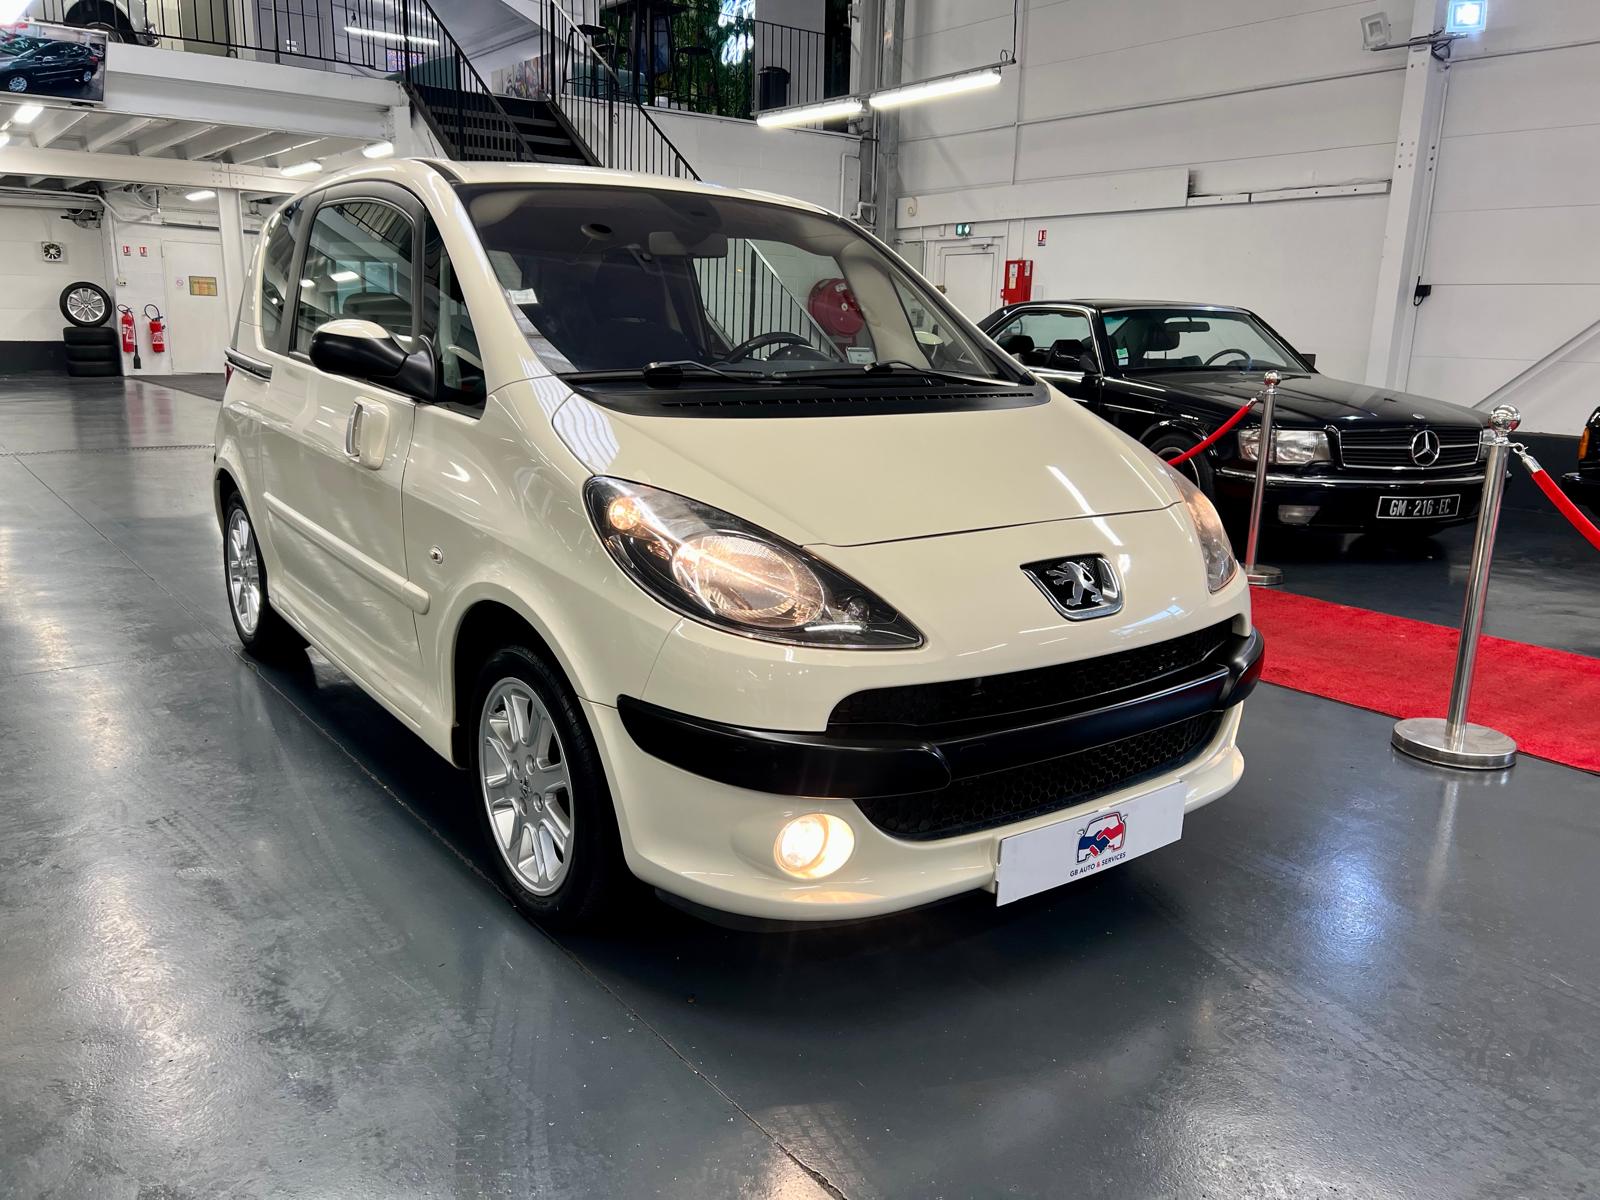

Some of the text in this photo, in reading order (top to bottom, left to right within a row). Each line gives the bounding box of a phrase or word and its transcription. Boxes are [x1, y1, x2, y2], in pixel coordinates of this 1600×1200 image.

[1069, 869, 1078, 877] GB
[1079, 863, 1096, 873] AUTO
[1101, 852, 1126, 866] SERVICES
